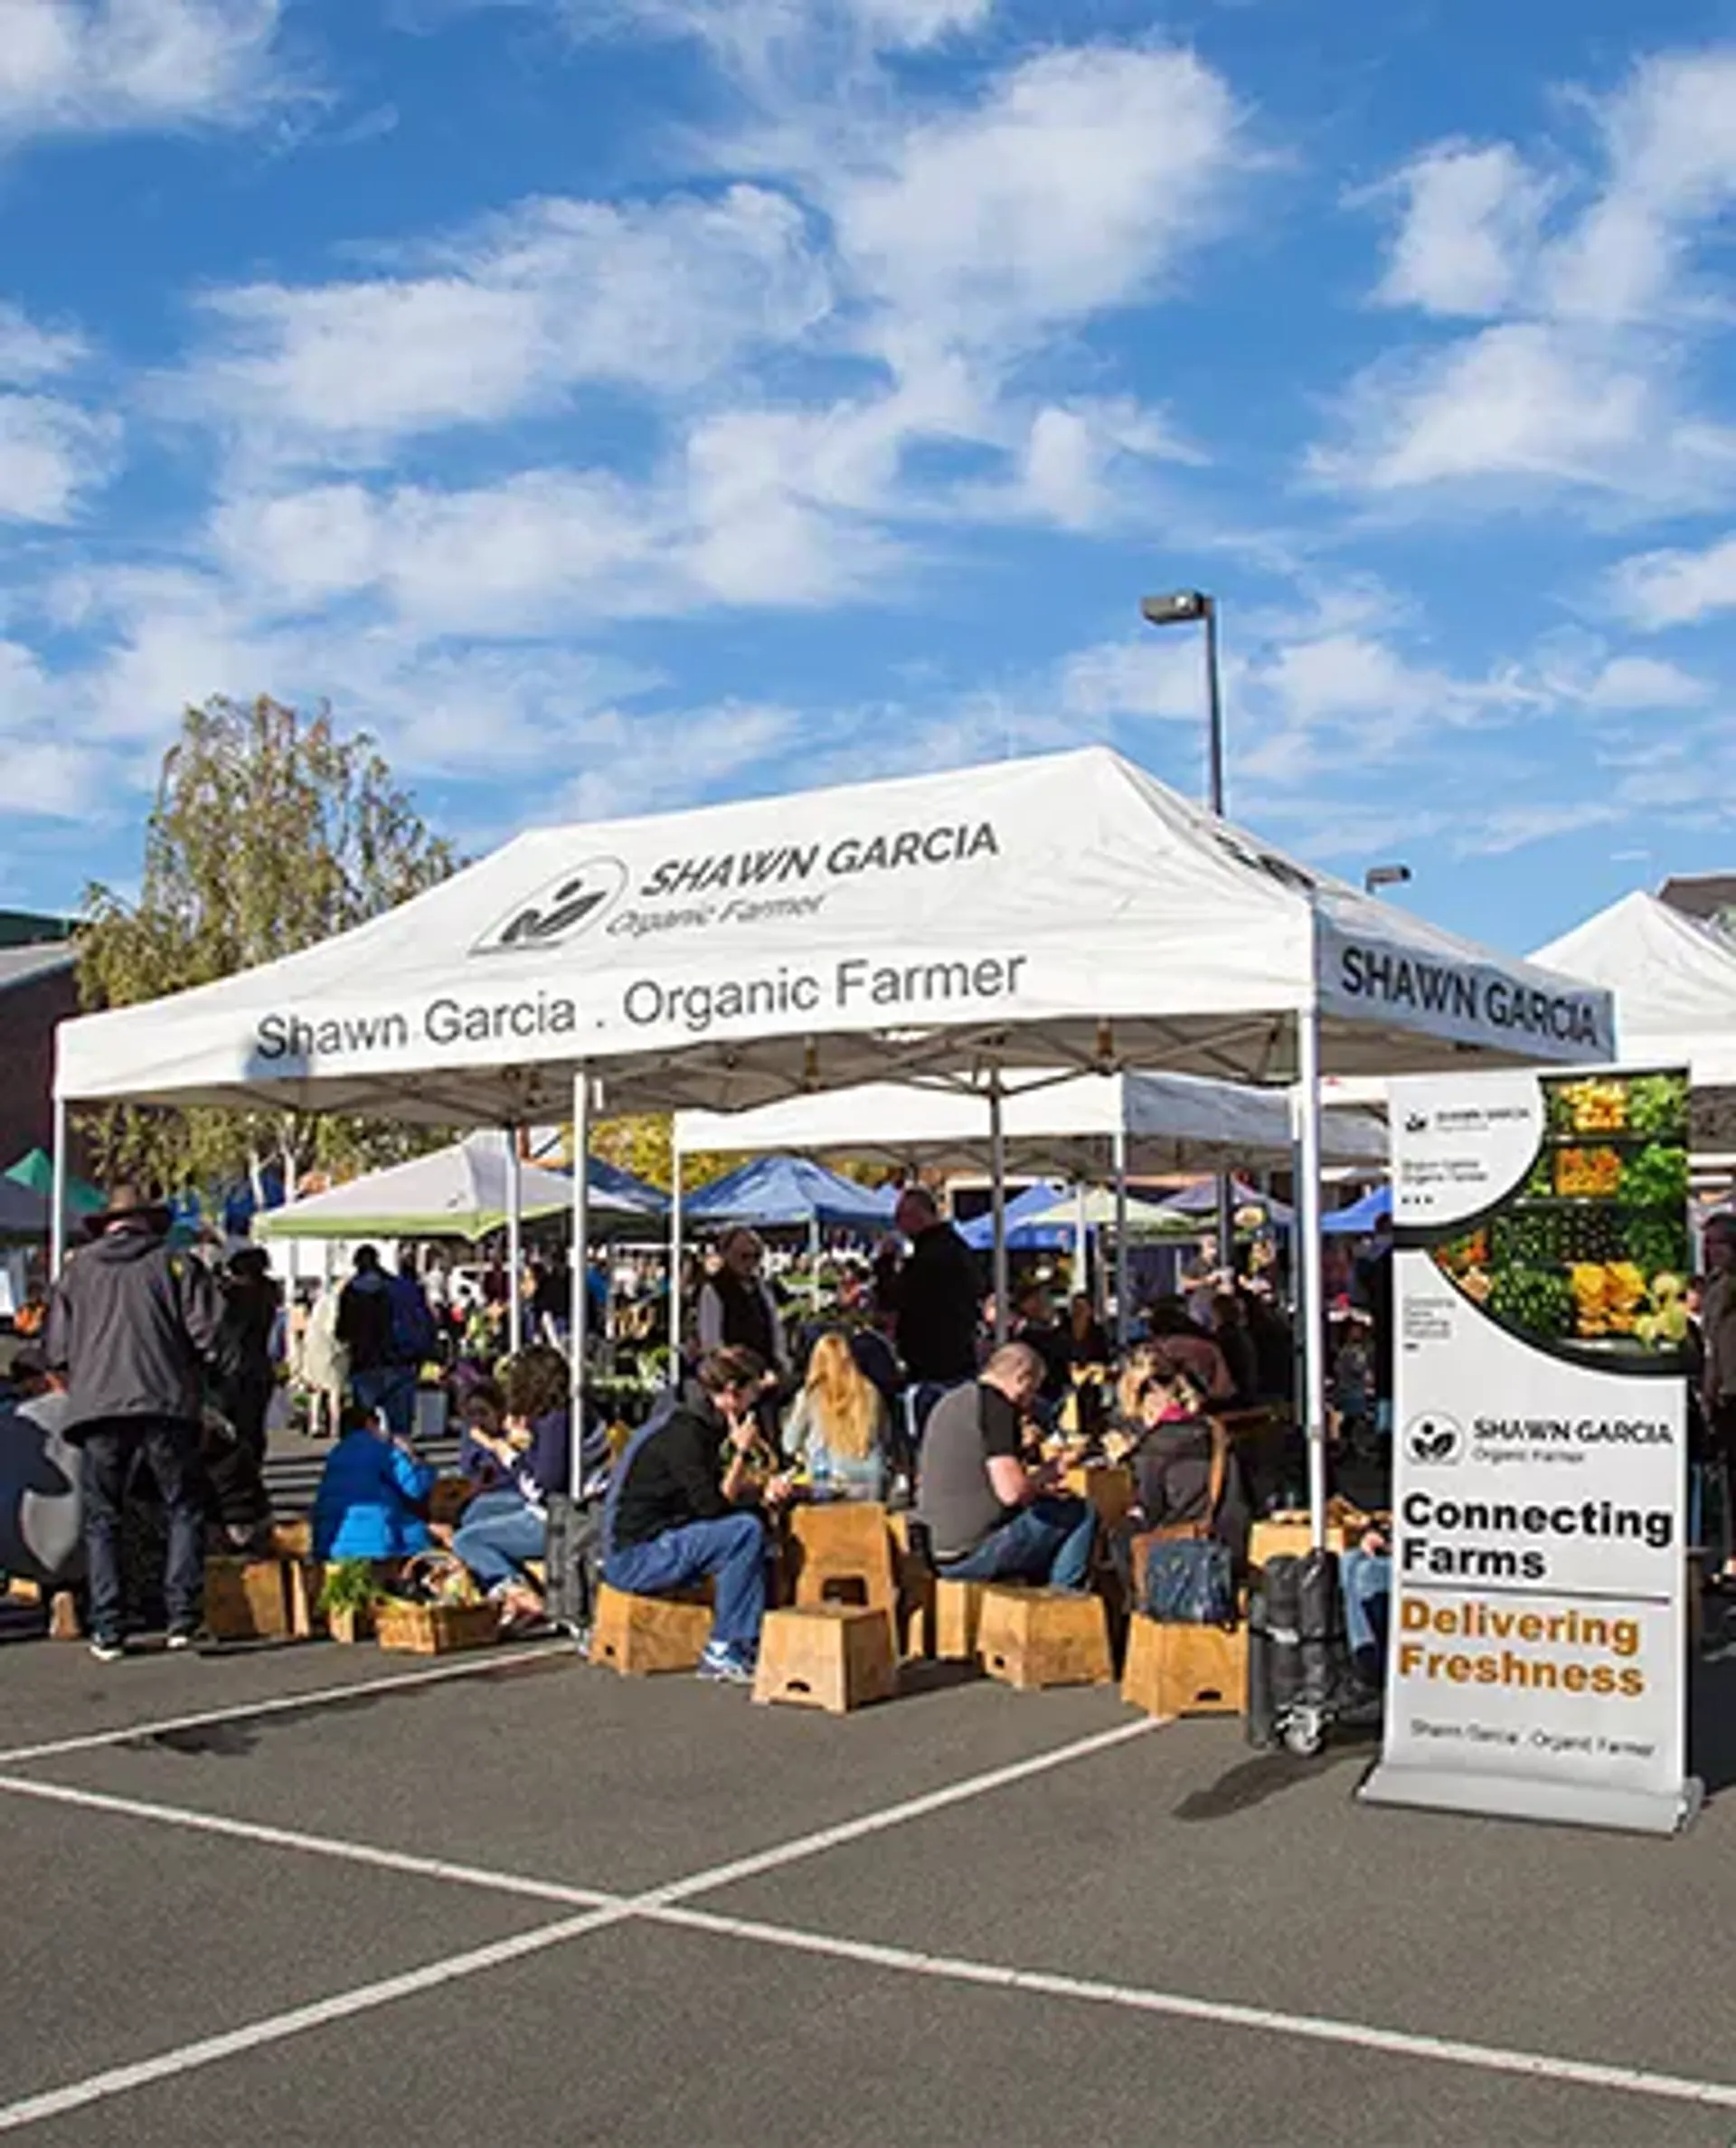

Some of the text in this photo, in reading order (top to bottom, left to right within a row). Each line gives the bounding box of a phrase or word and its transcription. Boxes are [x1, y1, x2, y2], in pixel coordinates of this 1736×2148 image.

[641, 821, 1000, 897] SHAWN GARCIA
[605, 893, 826, 939] Organic Farmer
[257, 1012, 407, 1059] Shawn
[424, 990, 576, 1044] Garcia
[624, 968, 819, 1031] Organic
[835, 954, 1027, 1008] Farmer
[1341, 945, 1598, 1046] SHAWN GARCIA
[1474, 1418, 1674, 1444] SHAWN GARCIA
[1402, 1492, 1673, 1548] Connecting
[1402, 1538, 1546, 1580] Farms
[1401, 1596, 1639, 1656] Delivering
[1399, 1644, 1645, 1697] Freshness
